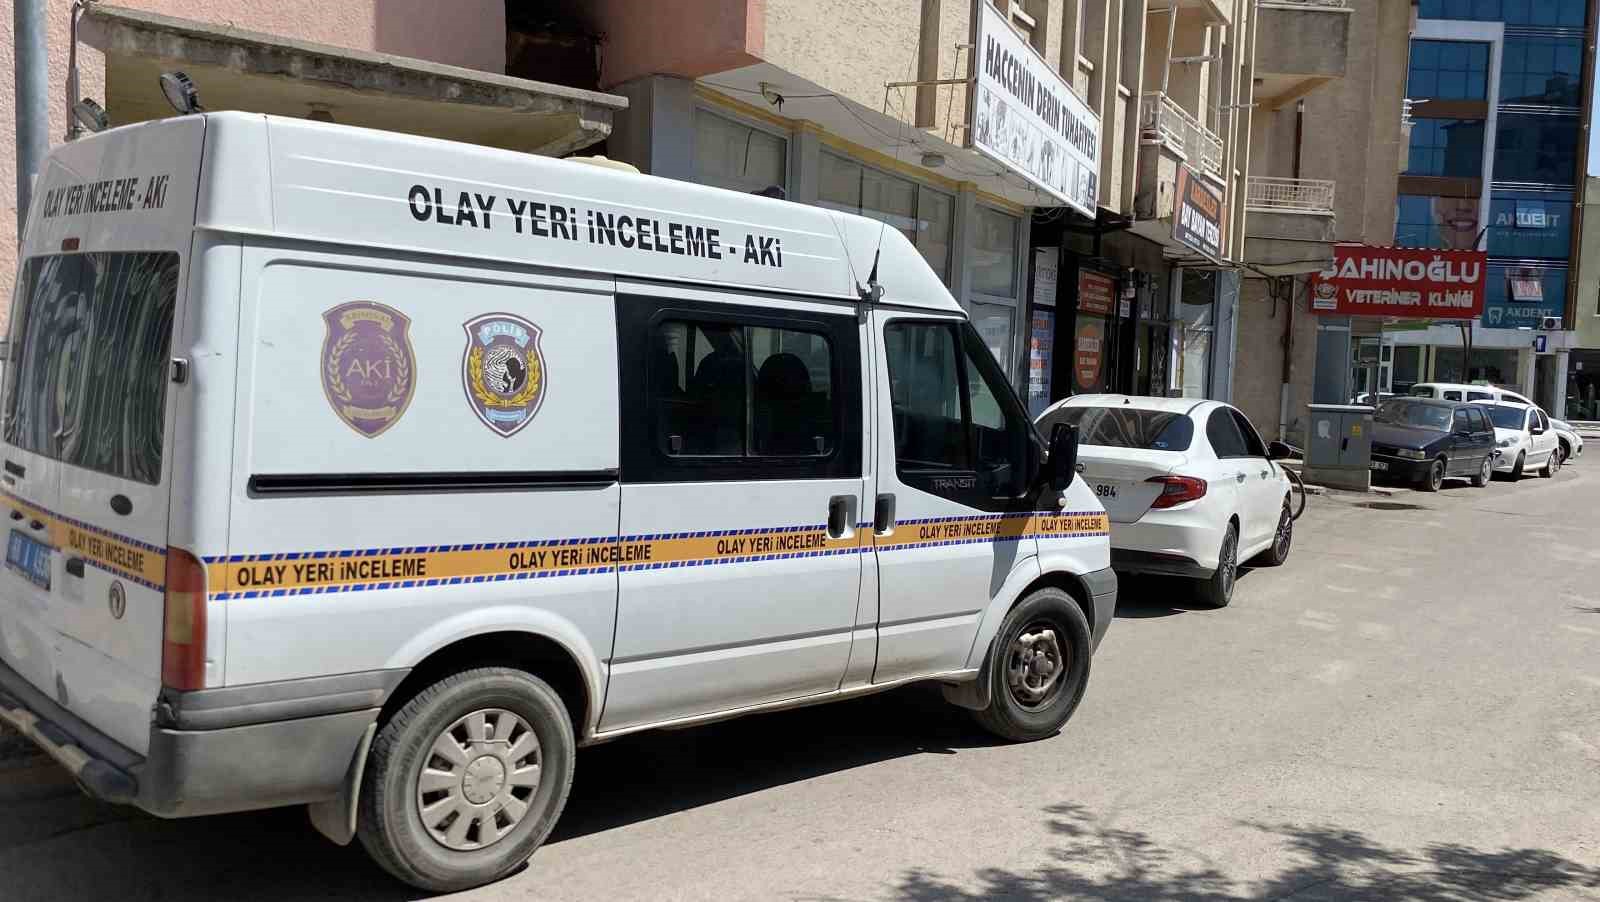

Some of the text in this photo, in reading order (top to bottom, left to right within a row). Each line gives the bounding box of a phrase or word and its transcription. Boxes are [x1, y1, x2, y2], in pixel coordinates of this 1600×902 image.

[407, 184, 497, 230] OLAY
[1096, 484, 1117, 498] 984
[919, 525, 941, 539] OLAY
[1041, 518, 1058, 531] OLAY
[717, 538, 746, 554] OLAY
[509, 550, 548, 570] OLAY
[238, 565, 287, 586] OLAY
